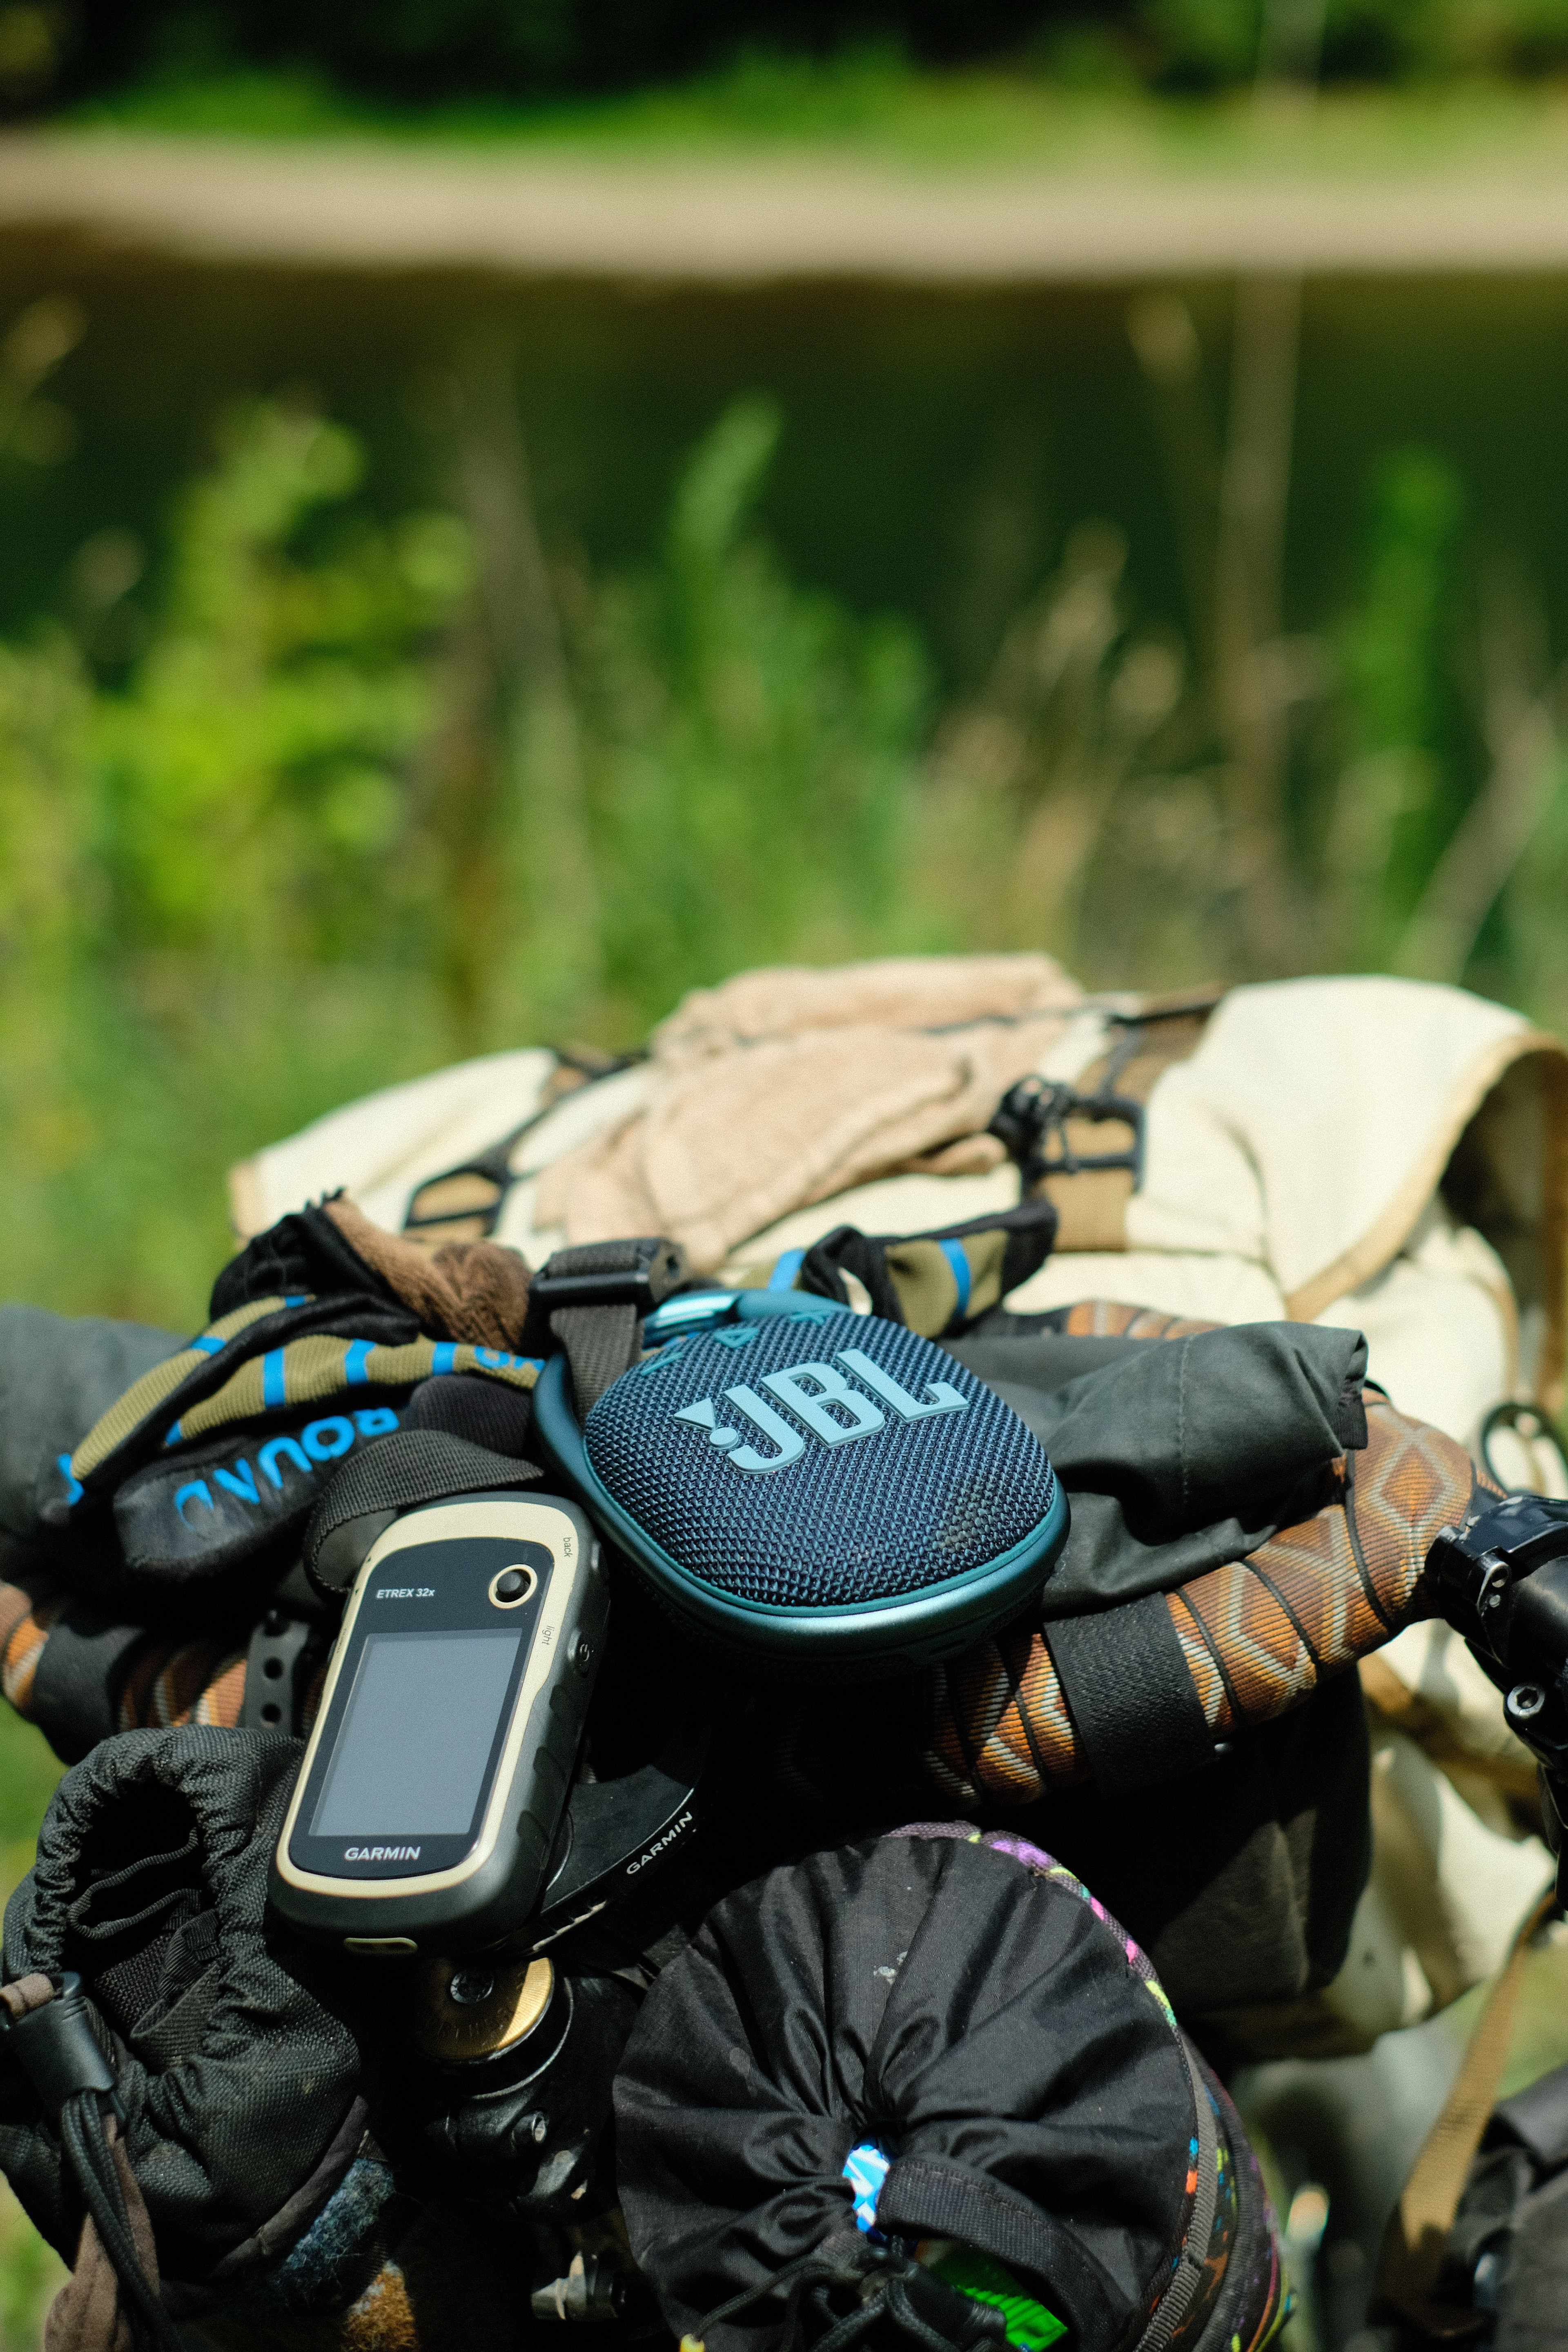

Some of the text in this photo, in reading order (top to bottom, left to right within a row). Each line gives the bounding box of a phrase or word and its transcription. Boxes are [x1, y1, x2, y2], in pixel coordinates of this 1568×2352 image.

[722, 1349, 969, 1474] JBL
[564, 1537, 572, 1557] back
[376, 1588, 436, 1598] ETREX 32x
[542, 1625, 555, 1645] light
[626, 1812, 693, 1874] GARMIN
[344, 1846, 421, 1861] GARMIN
